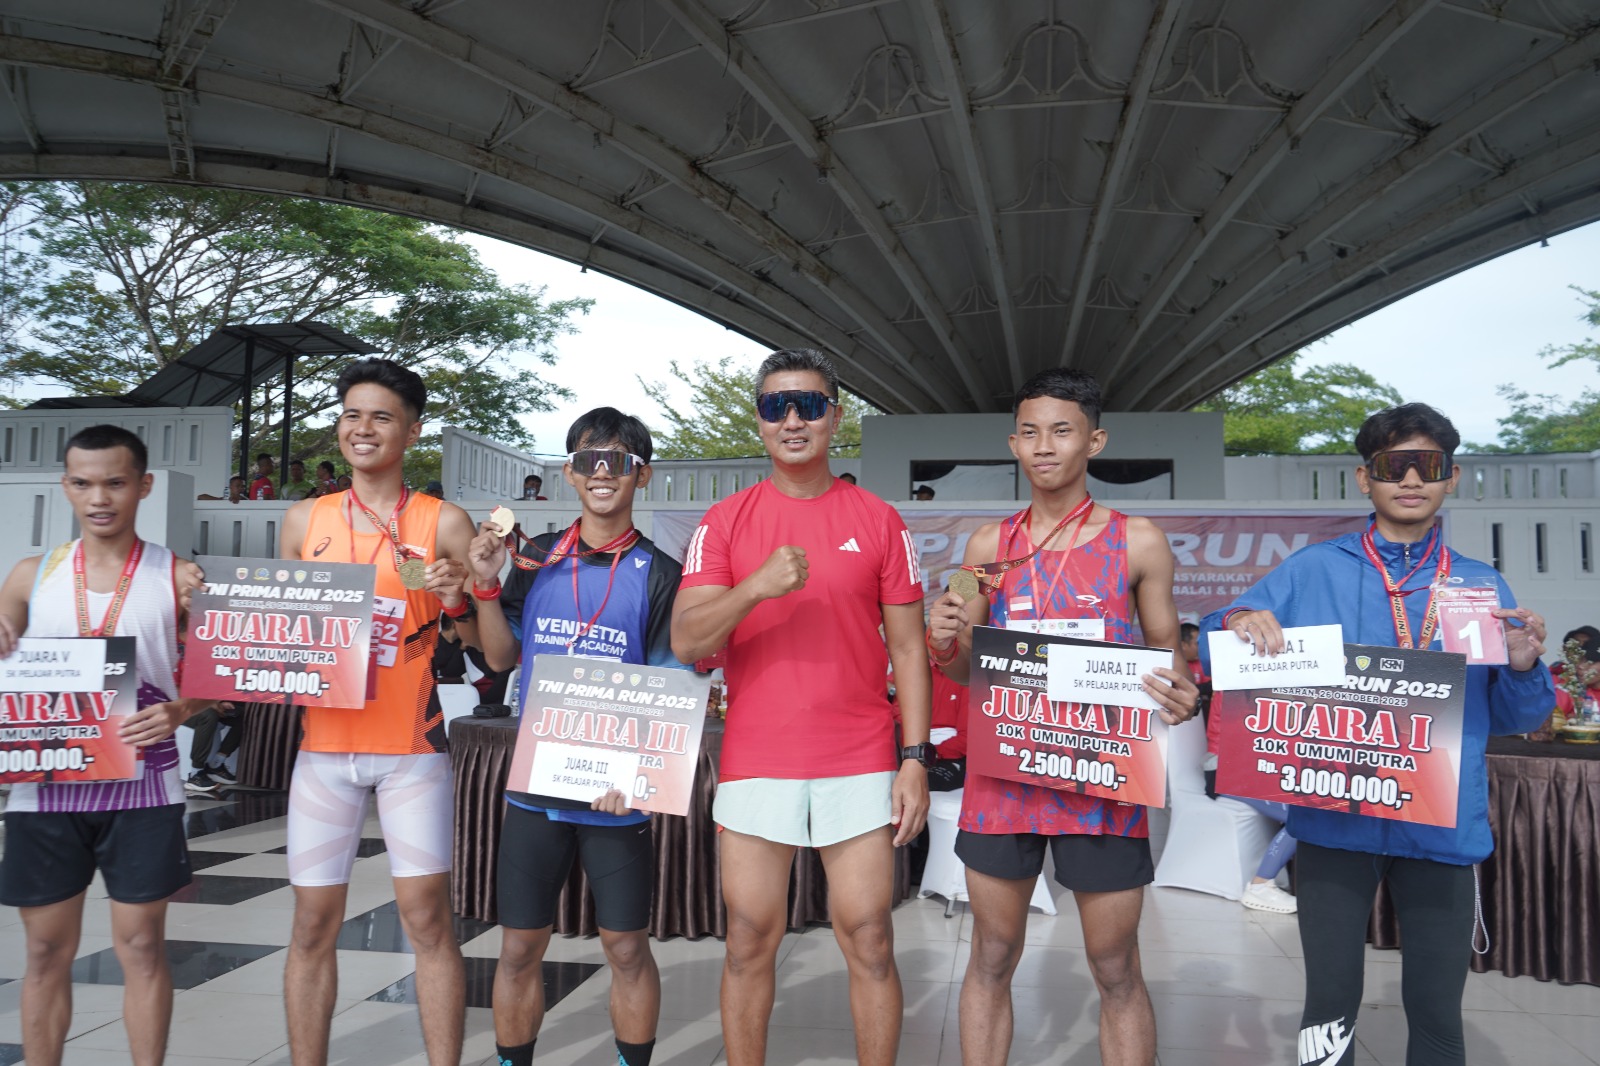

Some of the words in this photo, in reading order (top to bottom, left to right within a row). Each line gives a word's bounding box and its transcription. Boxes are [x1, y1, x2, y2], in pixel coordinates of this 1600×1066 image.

[1165, 533, 1309, 567] RUN
[1174, 573, 1253, 583] ASYARAKAT
[1216, 586, 1227, 595] &
[229, 584, 281, 599] PRIMA
[283, 587, 322, 601] RUN
[320, 589, 366, 603] 2025
[195, 610, 315, 646] JUARA
[320, 616, 363, 648] IV
[536, 617, 628, 646] VENDETTA
[1458, 620, 1484, 659] 1
[19, 651, 58, 663] JUARA
[62, 651, 71, 663] V
[212, 645, 241, 660] 10K
[244, 647, 291, 663] UMUM
[290, 649, 338, 665] PUTRA
[578, 640, 627, 656] ACADEMY
[980, 655, 1010, 671] TNI
[1009, 660, 1047, 676] PRIM
[1085, 660, 1122, 675] JUARA
[1125, 662, 1137, 676] II
[1239, 664, 1251, 673] 5K
[1252, 661, 1289, 672] PELAJAR
[1290, 659, 1319, 670] PUTRA
[233, 668, 330, 697] 1.500.000,-
[538, 680, 566, 694] TNI
[564, 683, 615, 701] PRIMA
[617, 689, 656, 705] RUN
[654, 694, 698, 710] 2025
[1074, 679, 1084, 688] 5K
[1086, 680, 1119, 691] PELAJAR
[1121, 683, 1144, 692] PUTR
[1344, 674, 1393, 694] RUN
[1393, 680, 1453, 700] 2025
[87, 690, 119, 720] V
[1319, 689, 1333, 700] 26
[1333, 691, 1380, 705] OKTOBER
[1381, 697, 1408, 707] 2025
[982, 685, 1110, 735] JUARA
[1117, 706, 1153, 742] II
[1245, 697, 1400, 748] JUARA
[1408, 714, 1432, 752] I
[46, 725, 102, 741] PUTRA
[532, 706, 640, 748] JUARA
[645, 720, 690, 755] III
[996, 723, 1026, 740] 10K
[1030, 729, 1079, 749] UMUM
[1079, 736, 1132, 757] PUTRA
[565, 757, 593, 772] JUARA
[595, 761, 609, 775] III
[999, 742, 1018, 757] Rp.
[1018, 748, 1127, 791] 2.500.000,-
[1253, 737, 1288, 756] 10K
[1295, 742, 1350, 763] UMUM
[1354, 748, 1417, 772] PUTRA
[563, 776, 591, 787] PELAJAR
[592, 779, 615, 790] PUTRA
[1257, 759, 1279, 774] Rp.
[1280, 765, 1411, 808] 3.000.000,-
[1298, 1016, 1348, 1066] NIKE
